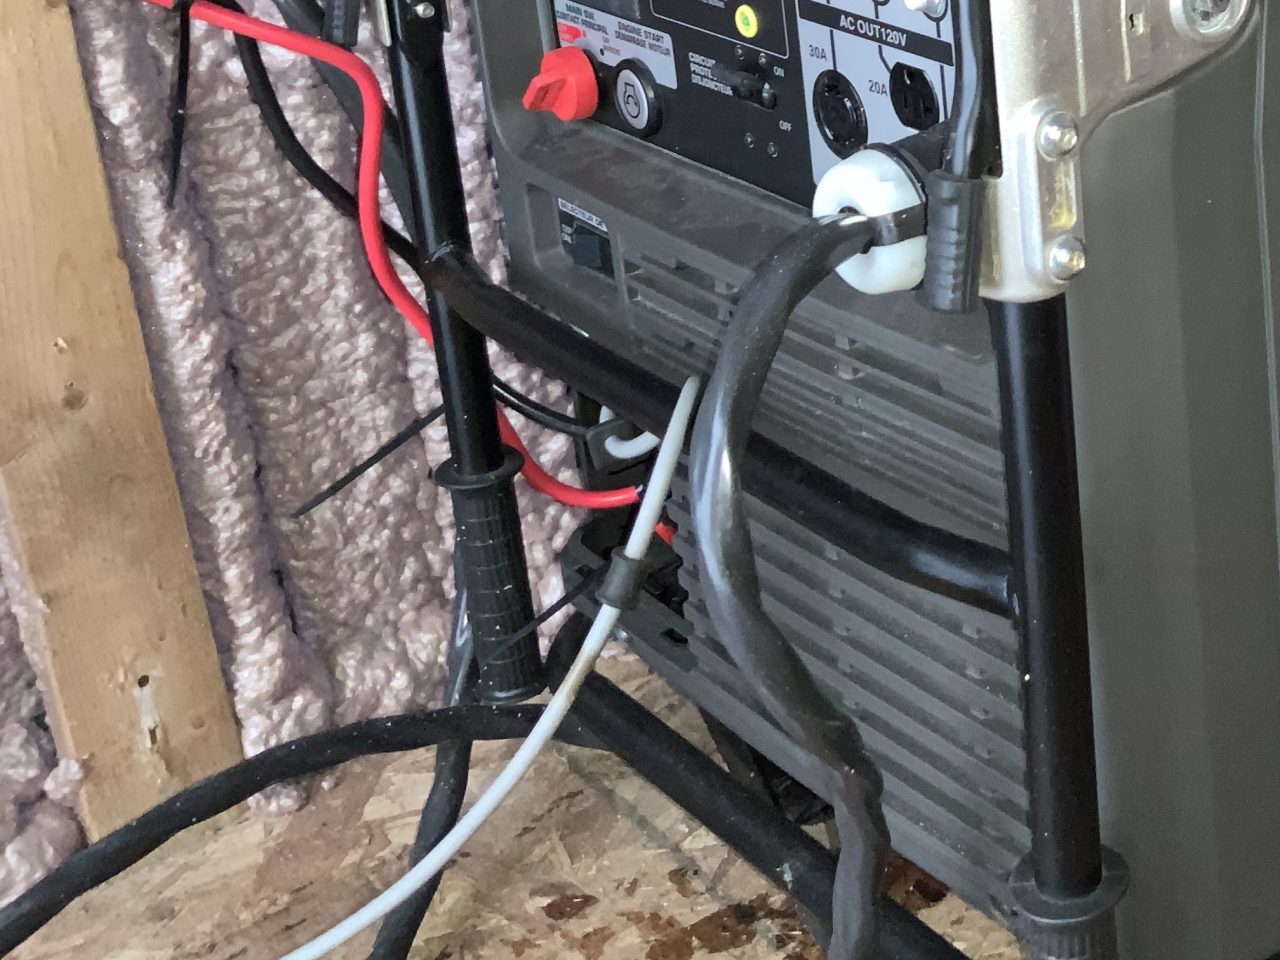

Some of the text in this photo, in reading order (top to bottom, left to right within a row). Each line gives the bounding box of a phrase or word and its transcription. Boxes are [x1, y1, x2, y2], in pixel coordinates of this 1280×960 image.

[839, 14, 856, 31] AC
[808, 44, 828, 62] 30A
[773, 66, 785, 77] ON
[868, 79, 888, 97] 20A
[779, 120, 792, 132] OFF
